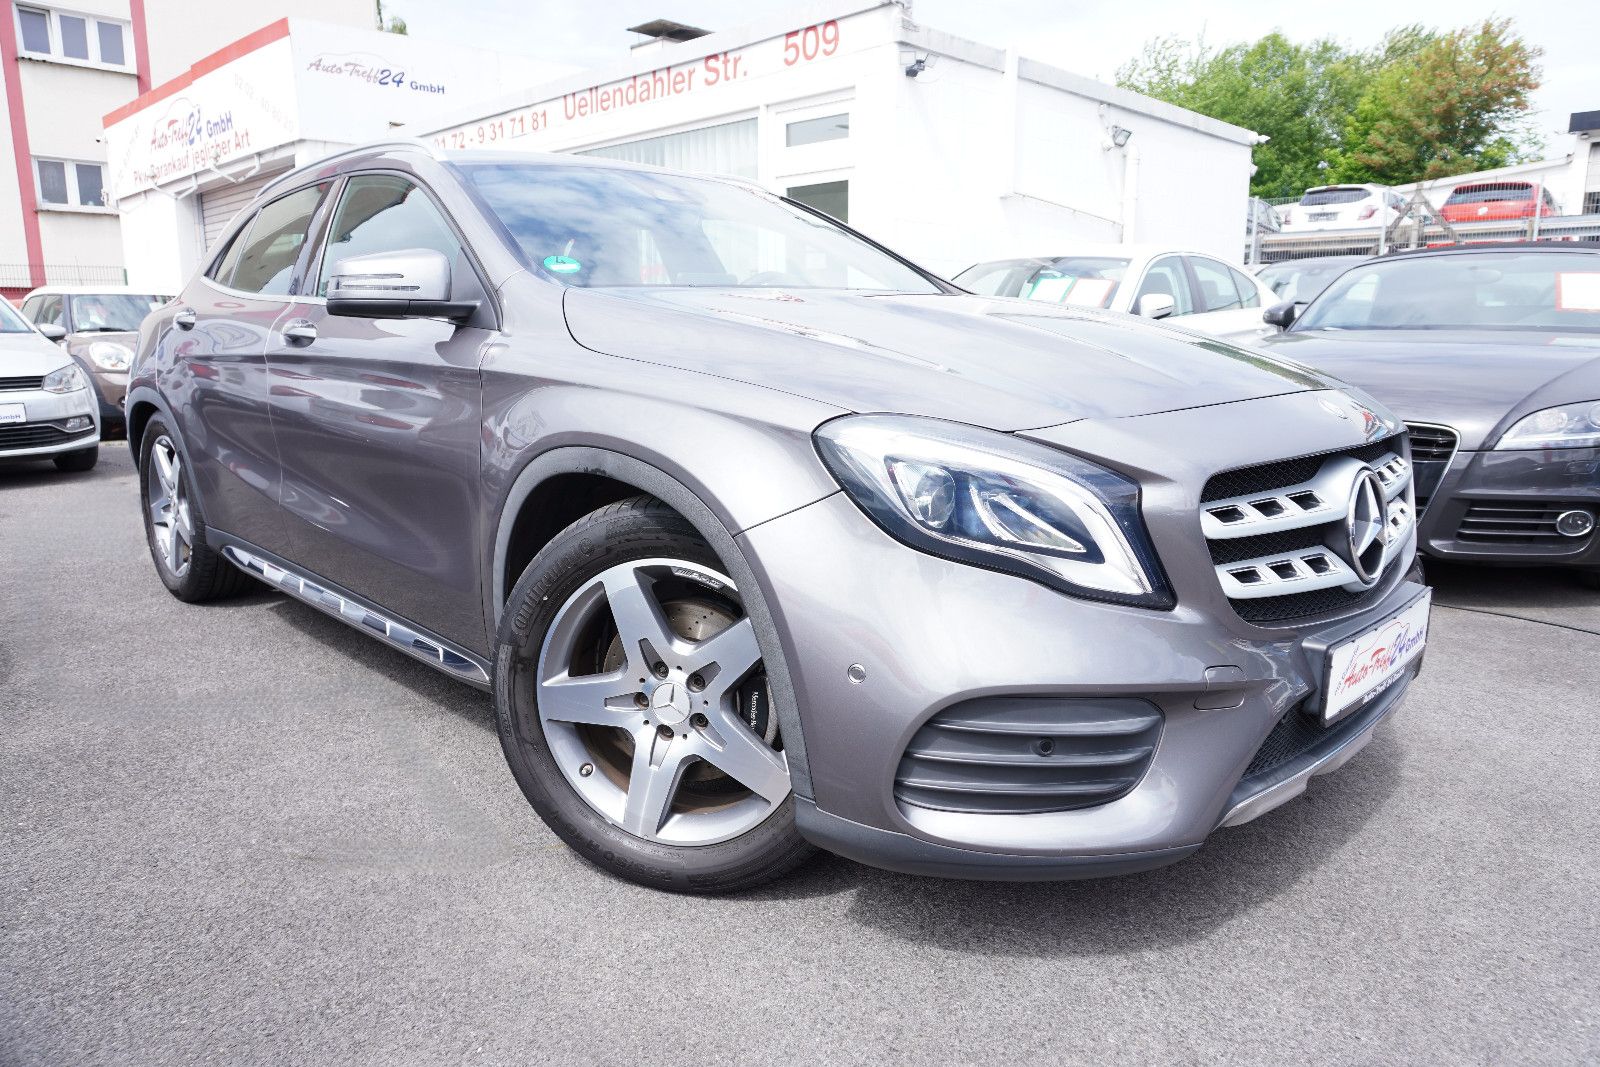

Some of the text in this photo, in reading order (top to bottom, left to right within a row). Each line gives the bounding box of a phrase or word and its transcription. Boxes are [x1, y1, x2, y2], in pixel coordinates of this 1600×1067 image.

[563, 19, 839, 120] Uellendahler Str. 509
[410, 81, 445, 94] GmbH
[206, 110, 233, 138] GmbH
[234, 129, 251, 152] Art
[451, 132, 465, 149] 72
